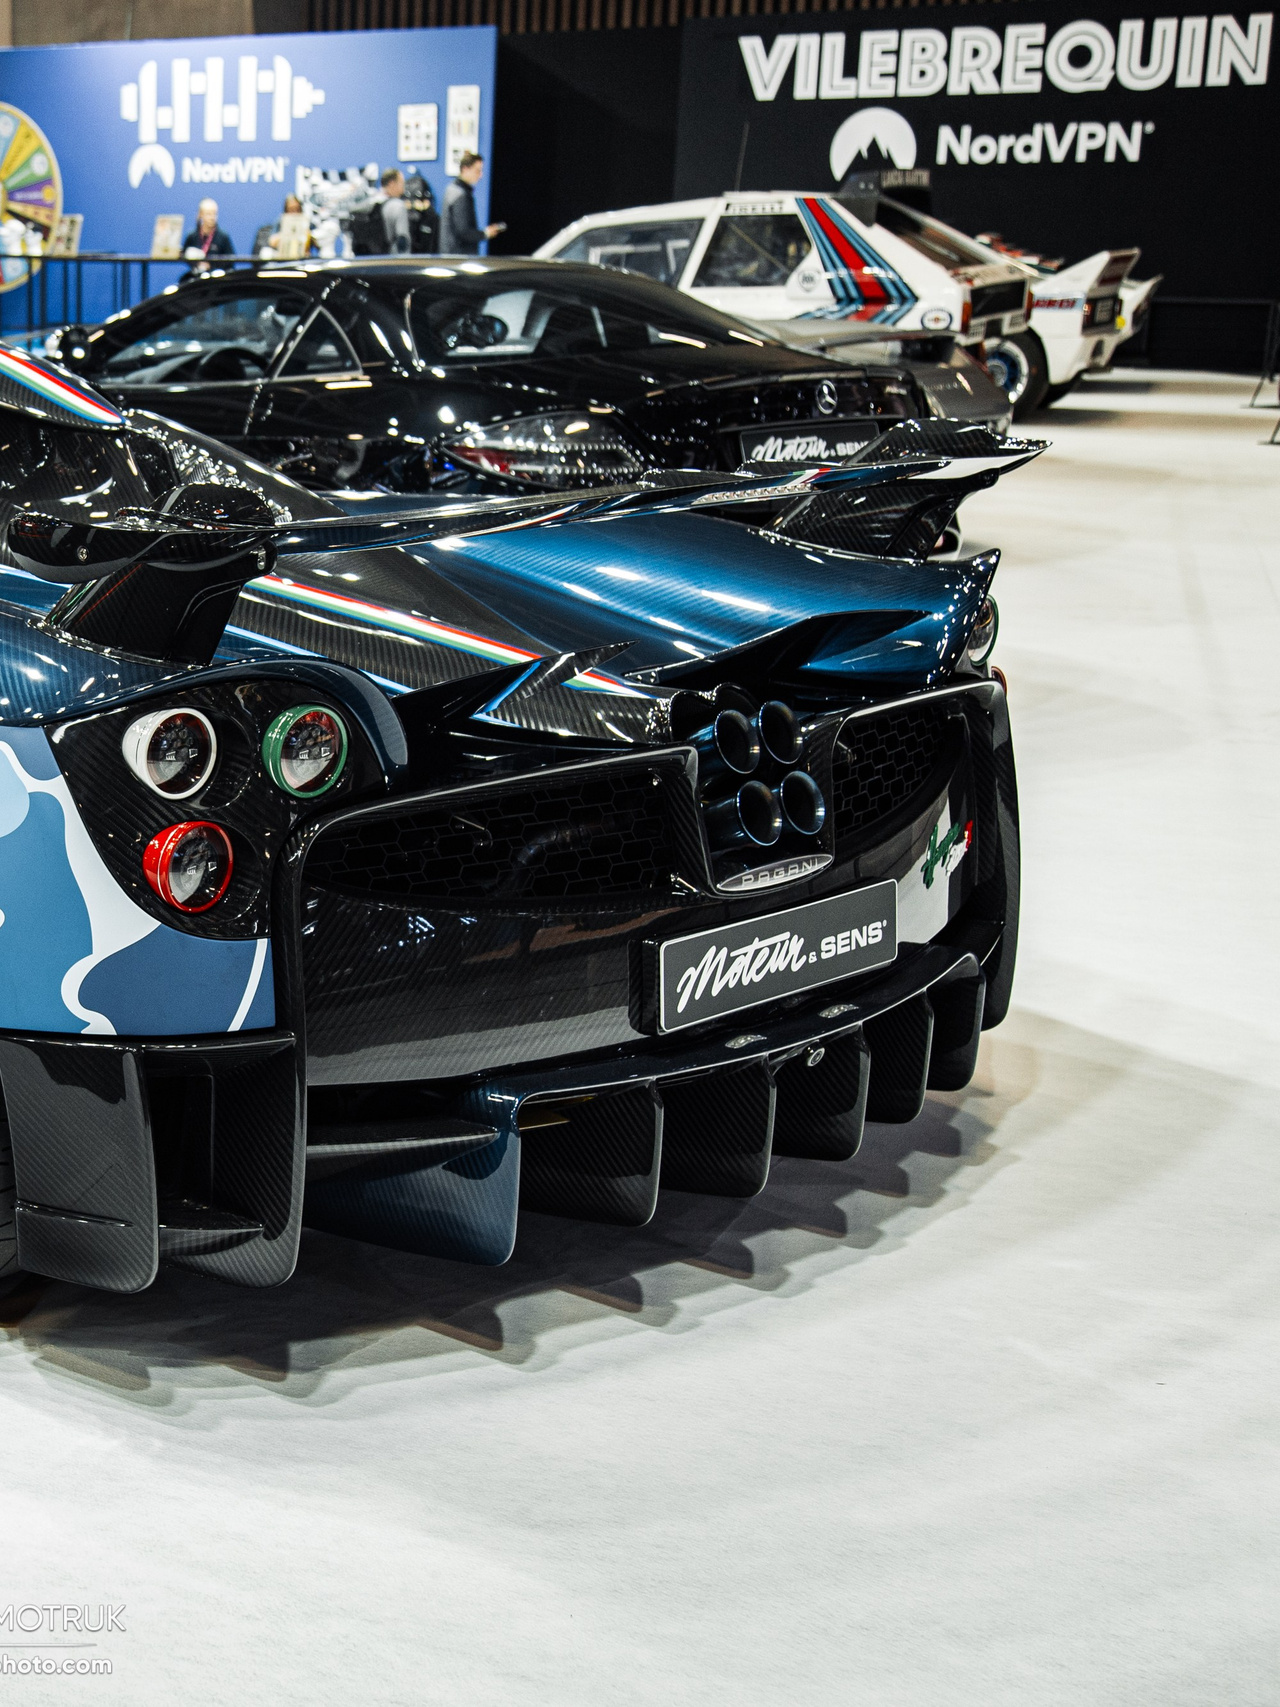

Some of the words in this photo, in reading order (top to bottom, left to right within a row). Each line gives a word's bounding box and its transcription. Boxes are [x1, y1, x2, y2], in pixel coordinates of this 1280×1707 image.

[738, 12, 1274, 101] VILEBREQUIN
[751, 436, 830, 460] Moteur
[741, 857, 819, 887] PAGANI
[676, 931, 807, 1014] Moteur
[808, 951, 818, 964] &
